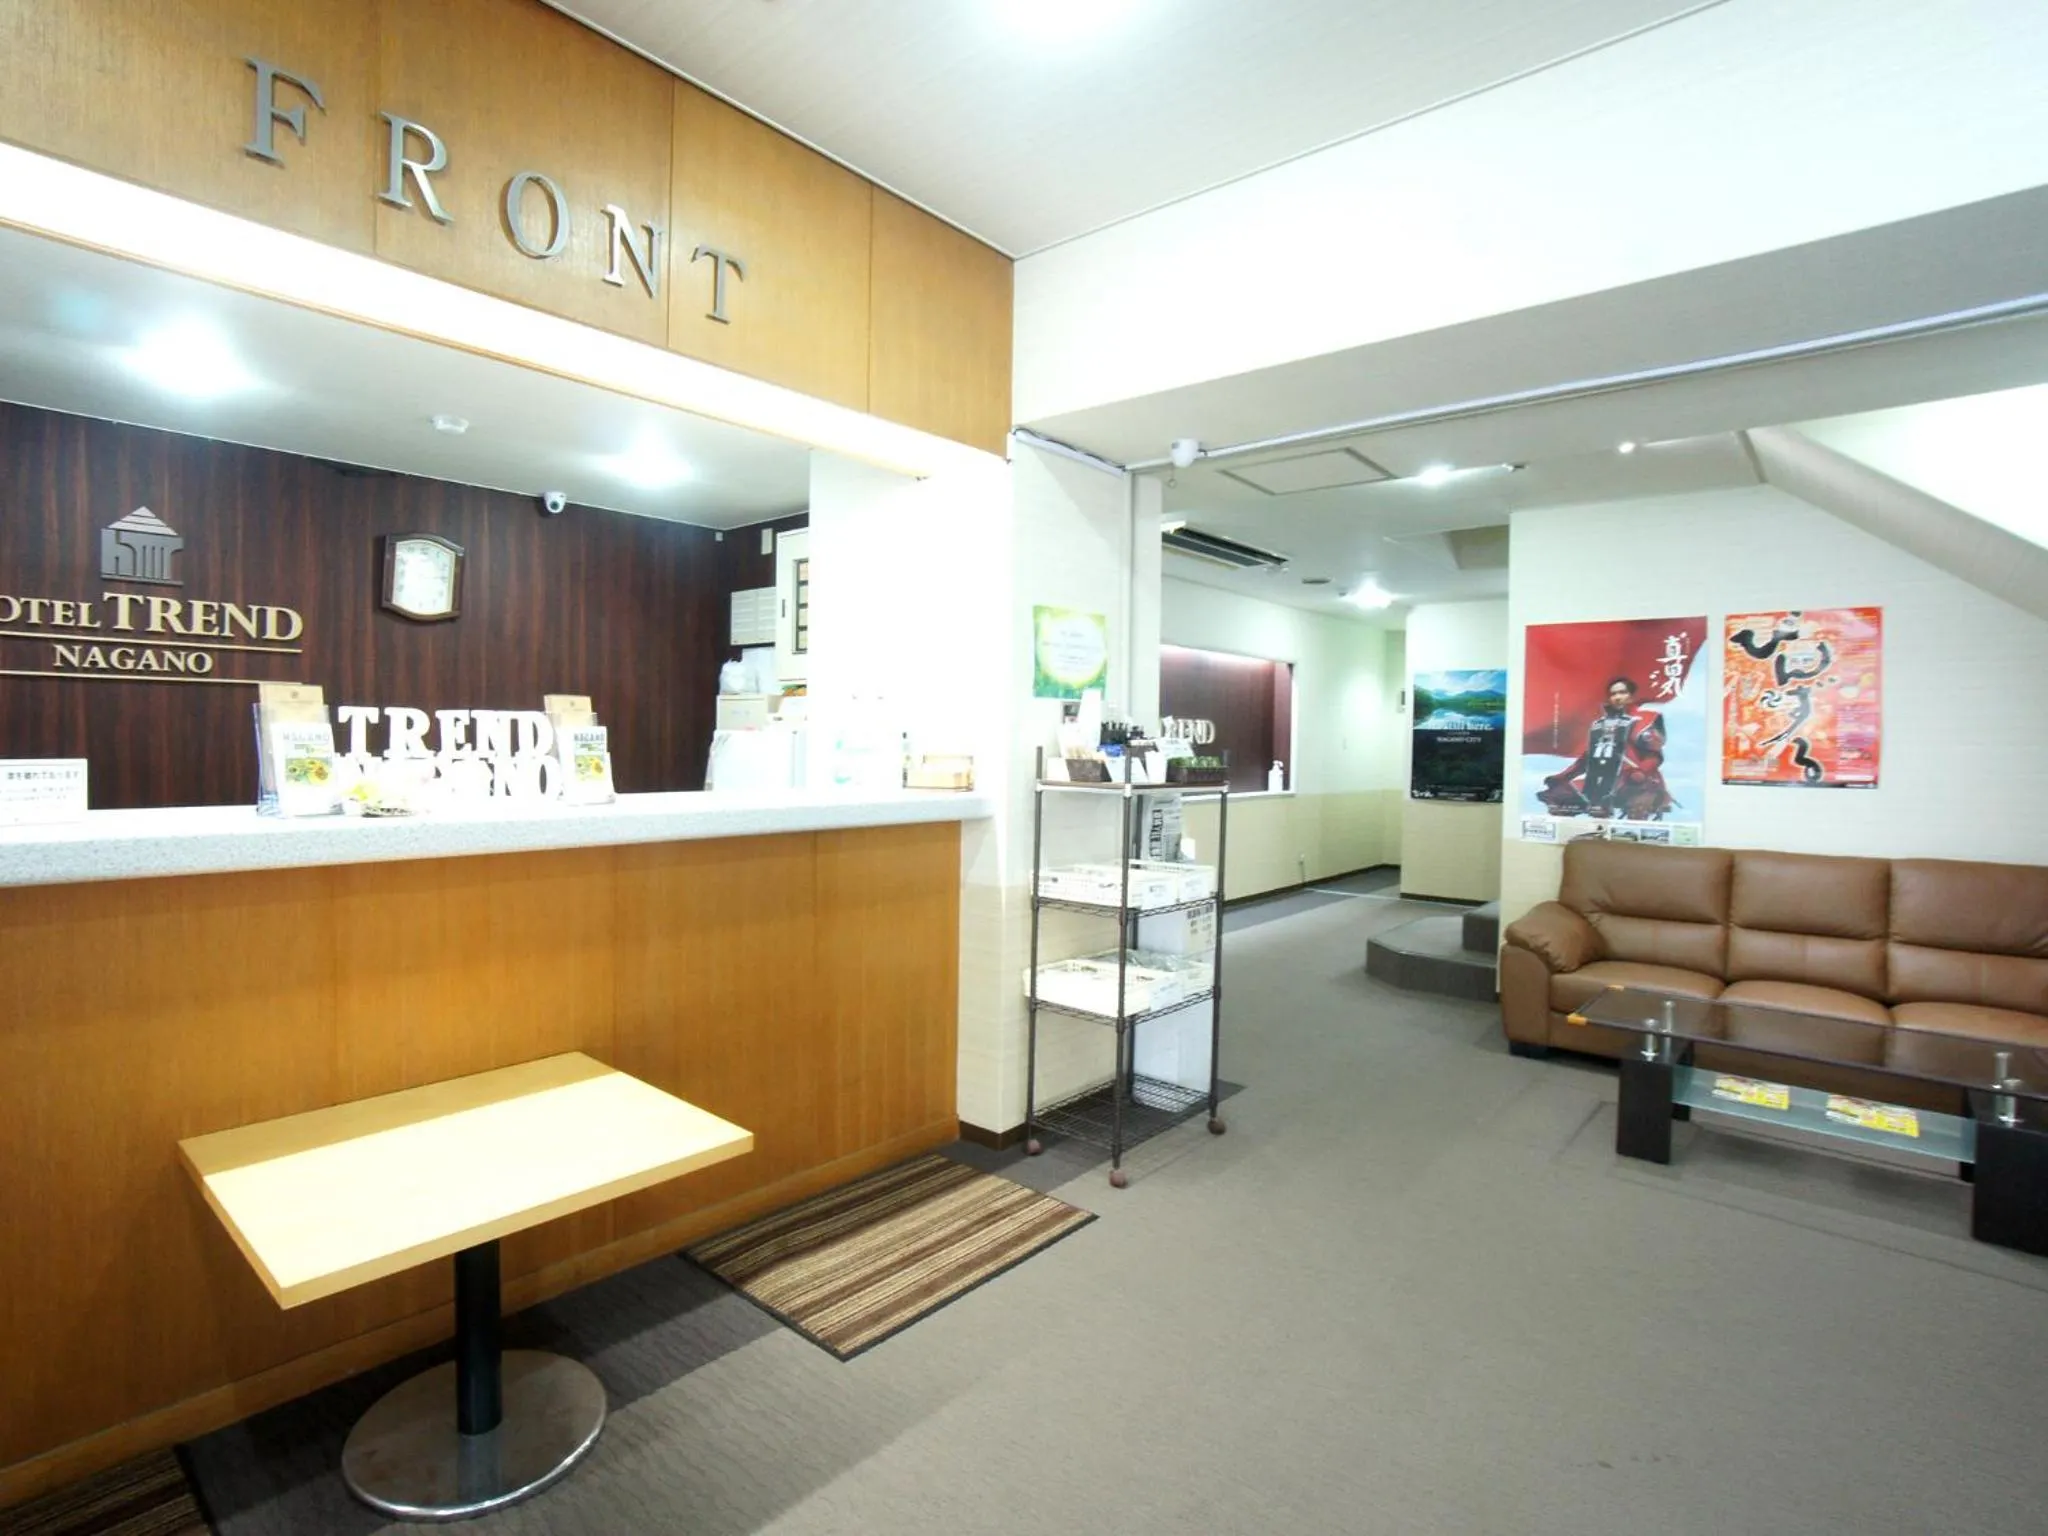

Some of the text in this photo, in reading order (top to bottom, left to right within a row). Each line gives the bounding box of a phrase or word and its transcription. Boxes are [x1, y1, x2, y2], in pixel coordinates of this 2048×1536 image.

[244, 56, 744, 323] FRONT
[0, 592, 304, 641] OTEL TREND
[53, 644, 213, 673] NAGANO
[338, 706, 553, 759] TREND
